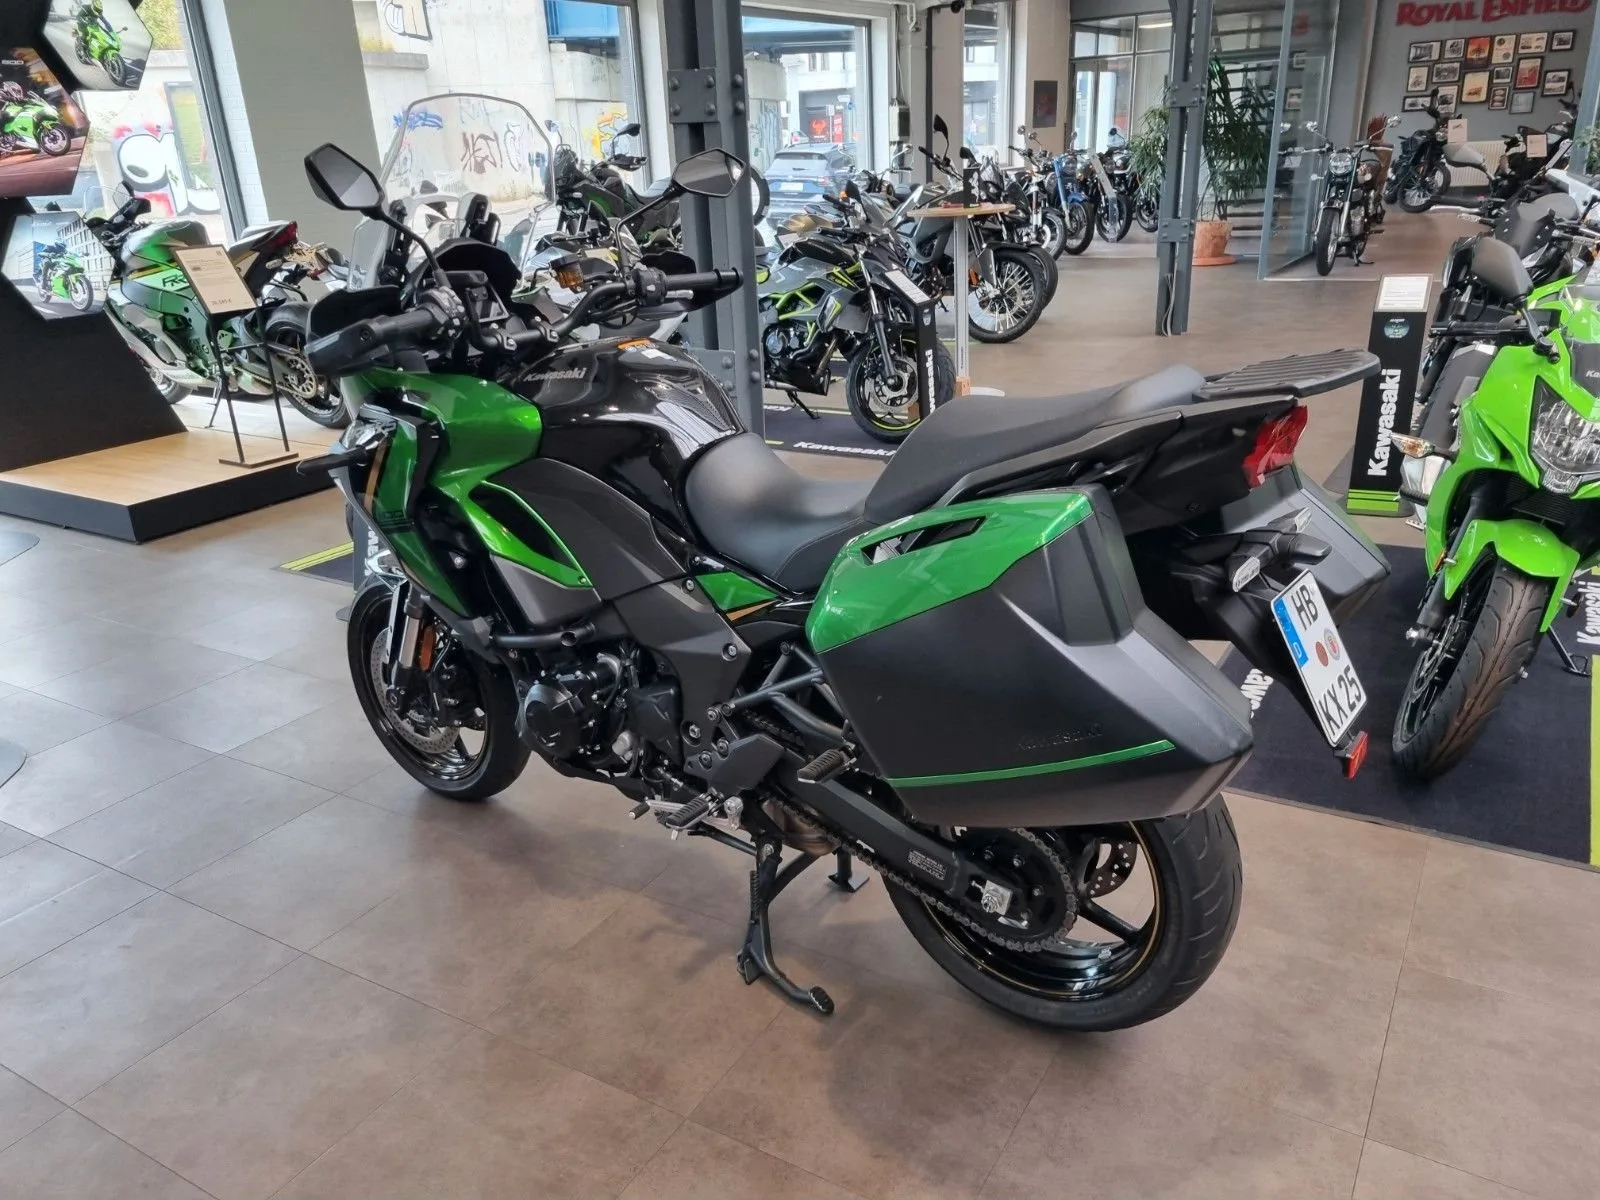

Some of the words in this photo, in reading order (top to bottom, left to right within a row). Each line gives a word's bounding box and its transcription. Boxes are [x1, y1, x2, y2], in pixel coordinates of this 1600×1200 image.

[1396, 1, 1479, 26] ROYAL
[1482, 0, 1591, 23] ENFIELD
[523, 367, 587, 382] Kawasaki
[1367, 368, 1402, 476] Kawasaki
[793, 441, 897, 456] Kawasaki
[1291, 584, 1318, 631] HB
[1318, 683, 1348, 736] KX
[1337, 664, 1362, 713] 25
